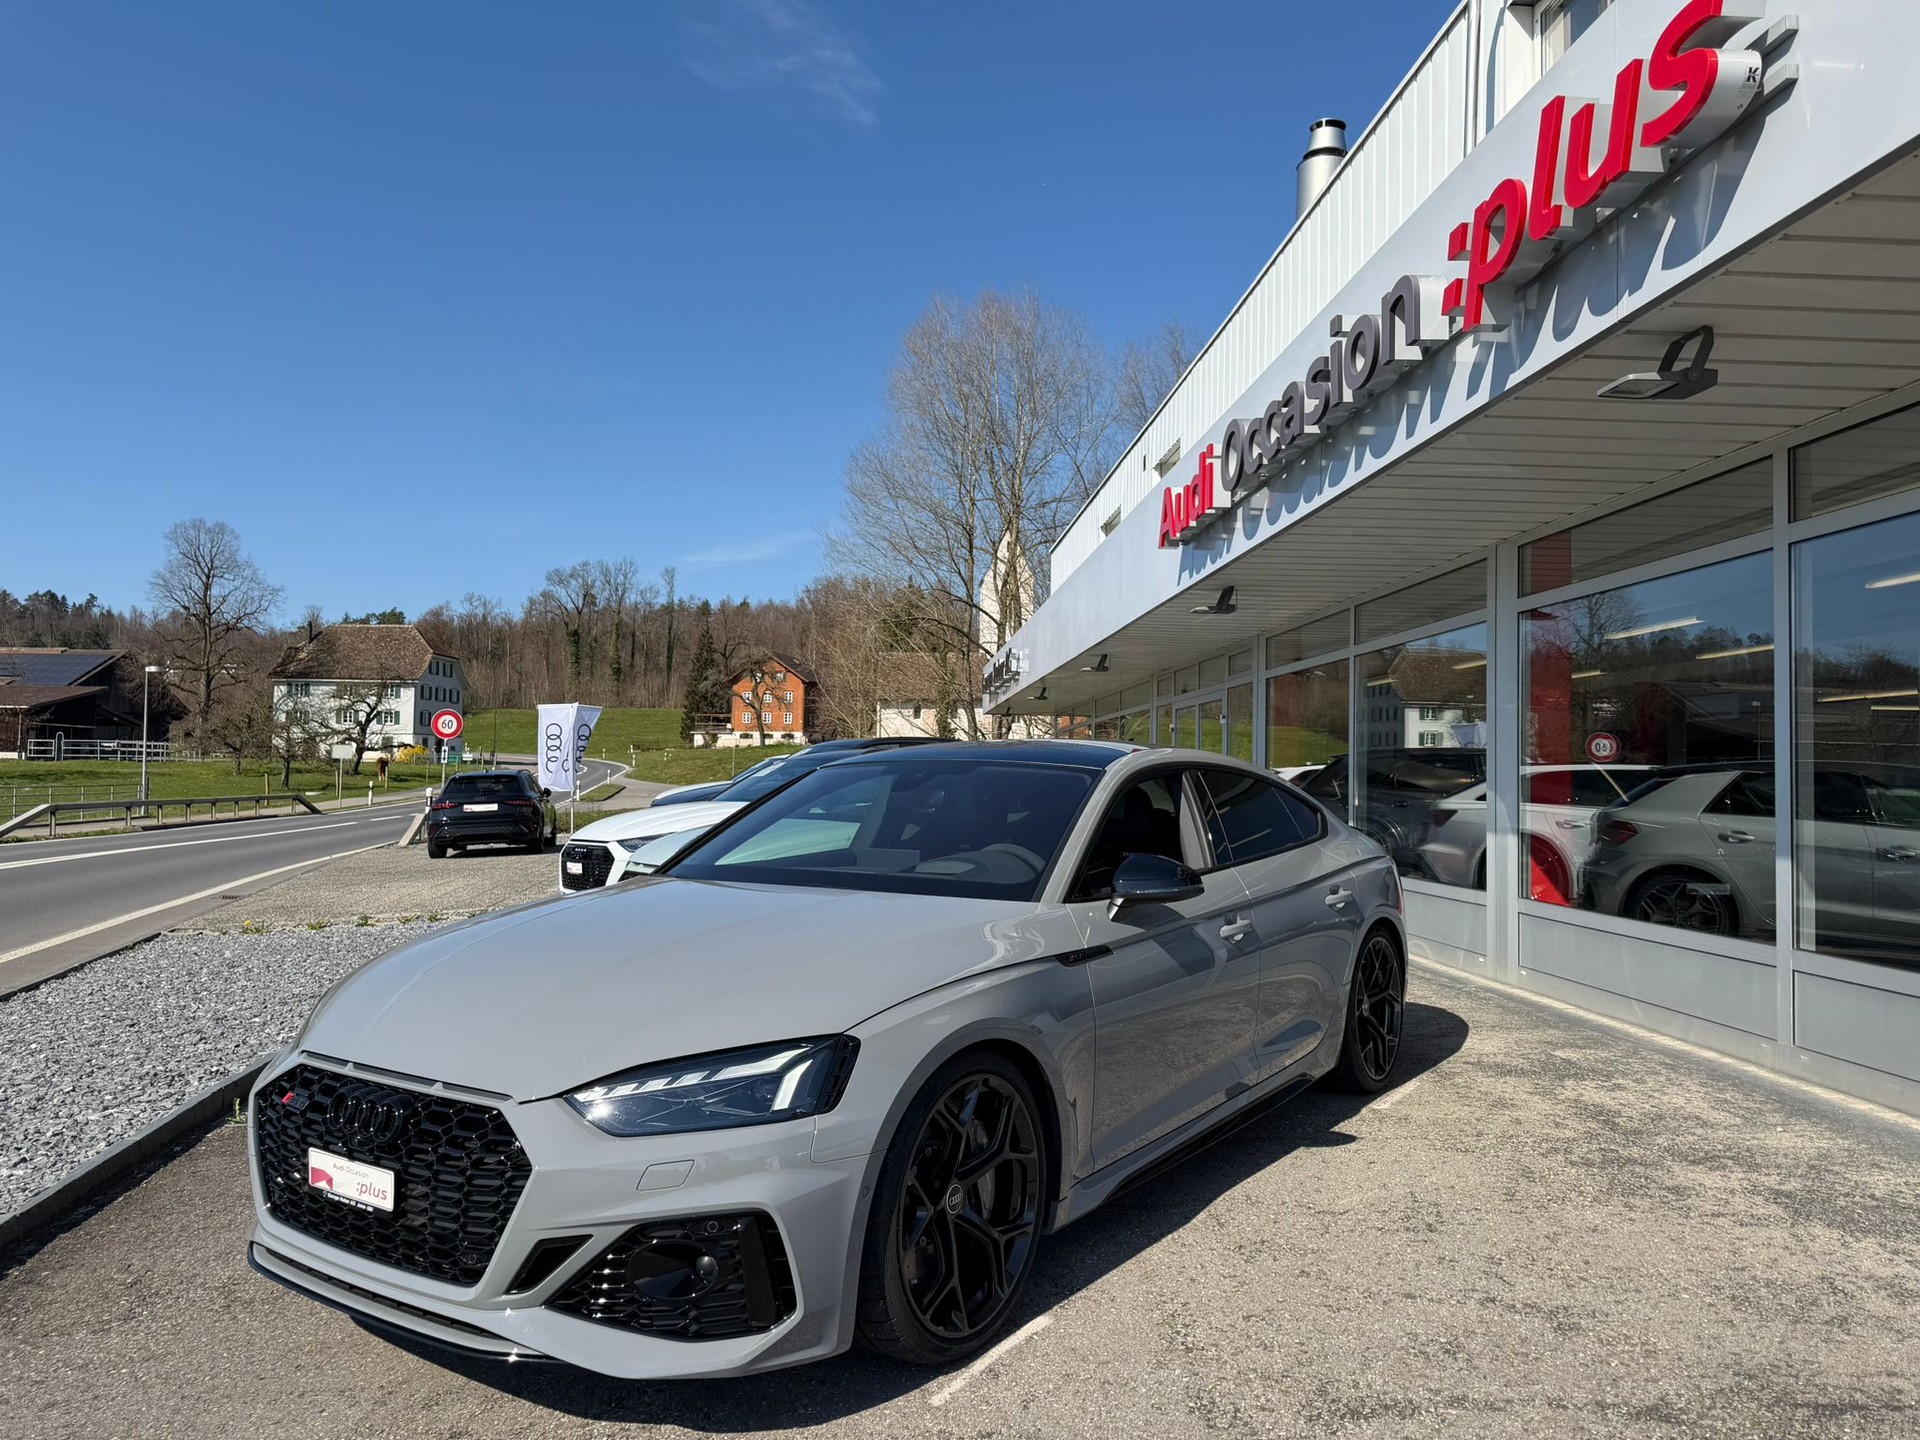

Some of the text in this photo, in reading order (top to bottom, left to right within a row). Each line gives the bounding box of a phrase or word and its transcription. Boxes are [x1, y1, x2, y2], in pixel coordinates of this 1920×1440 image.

[1159, 0, 1722, 549] Audi Occasion :plus
[441, 719, 453, 730] 60
[356, 1181, 388, 1201] :plus
